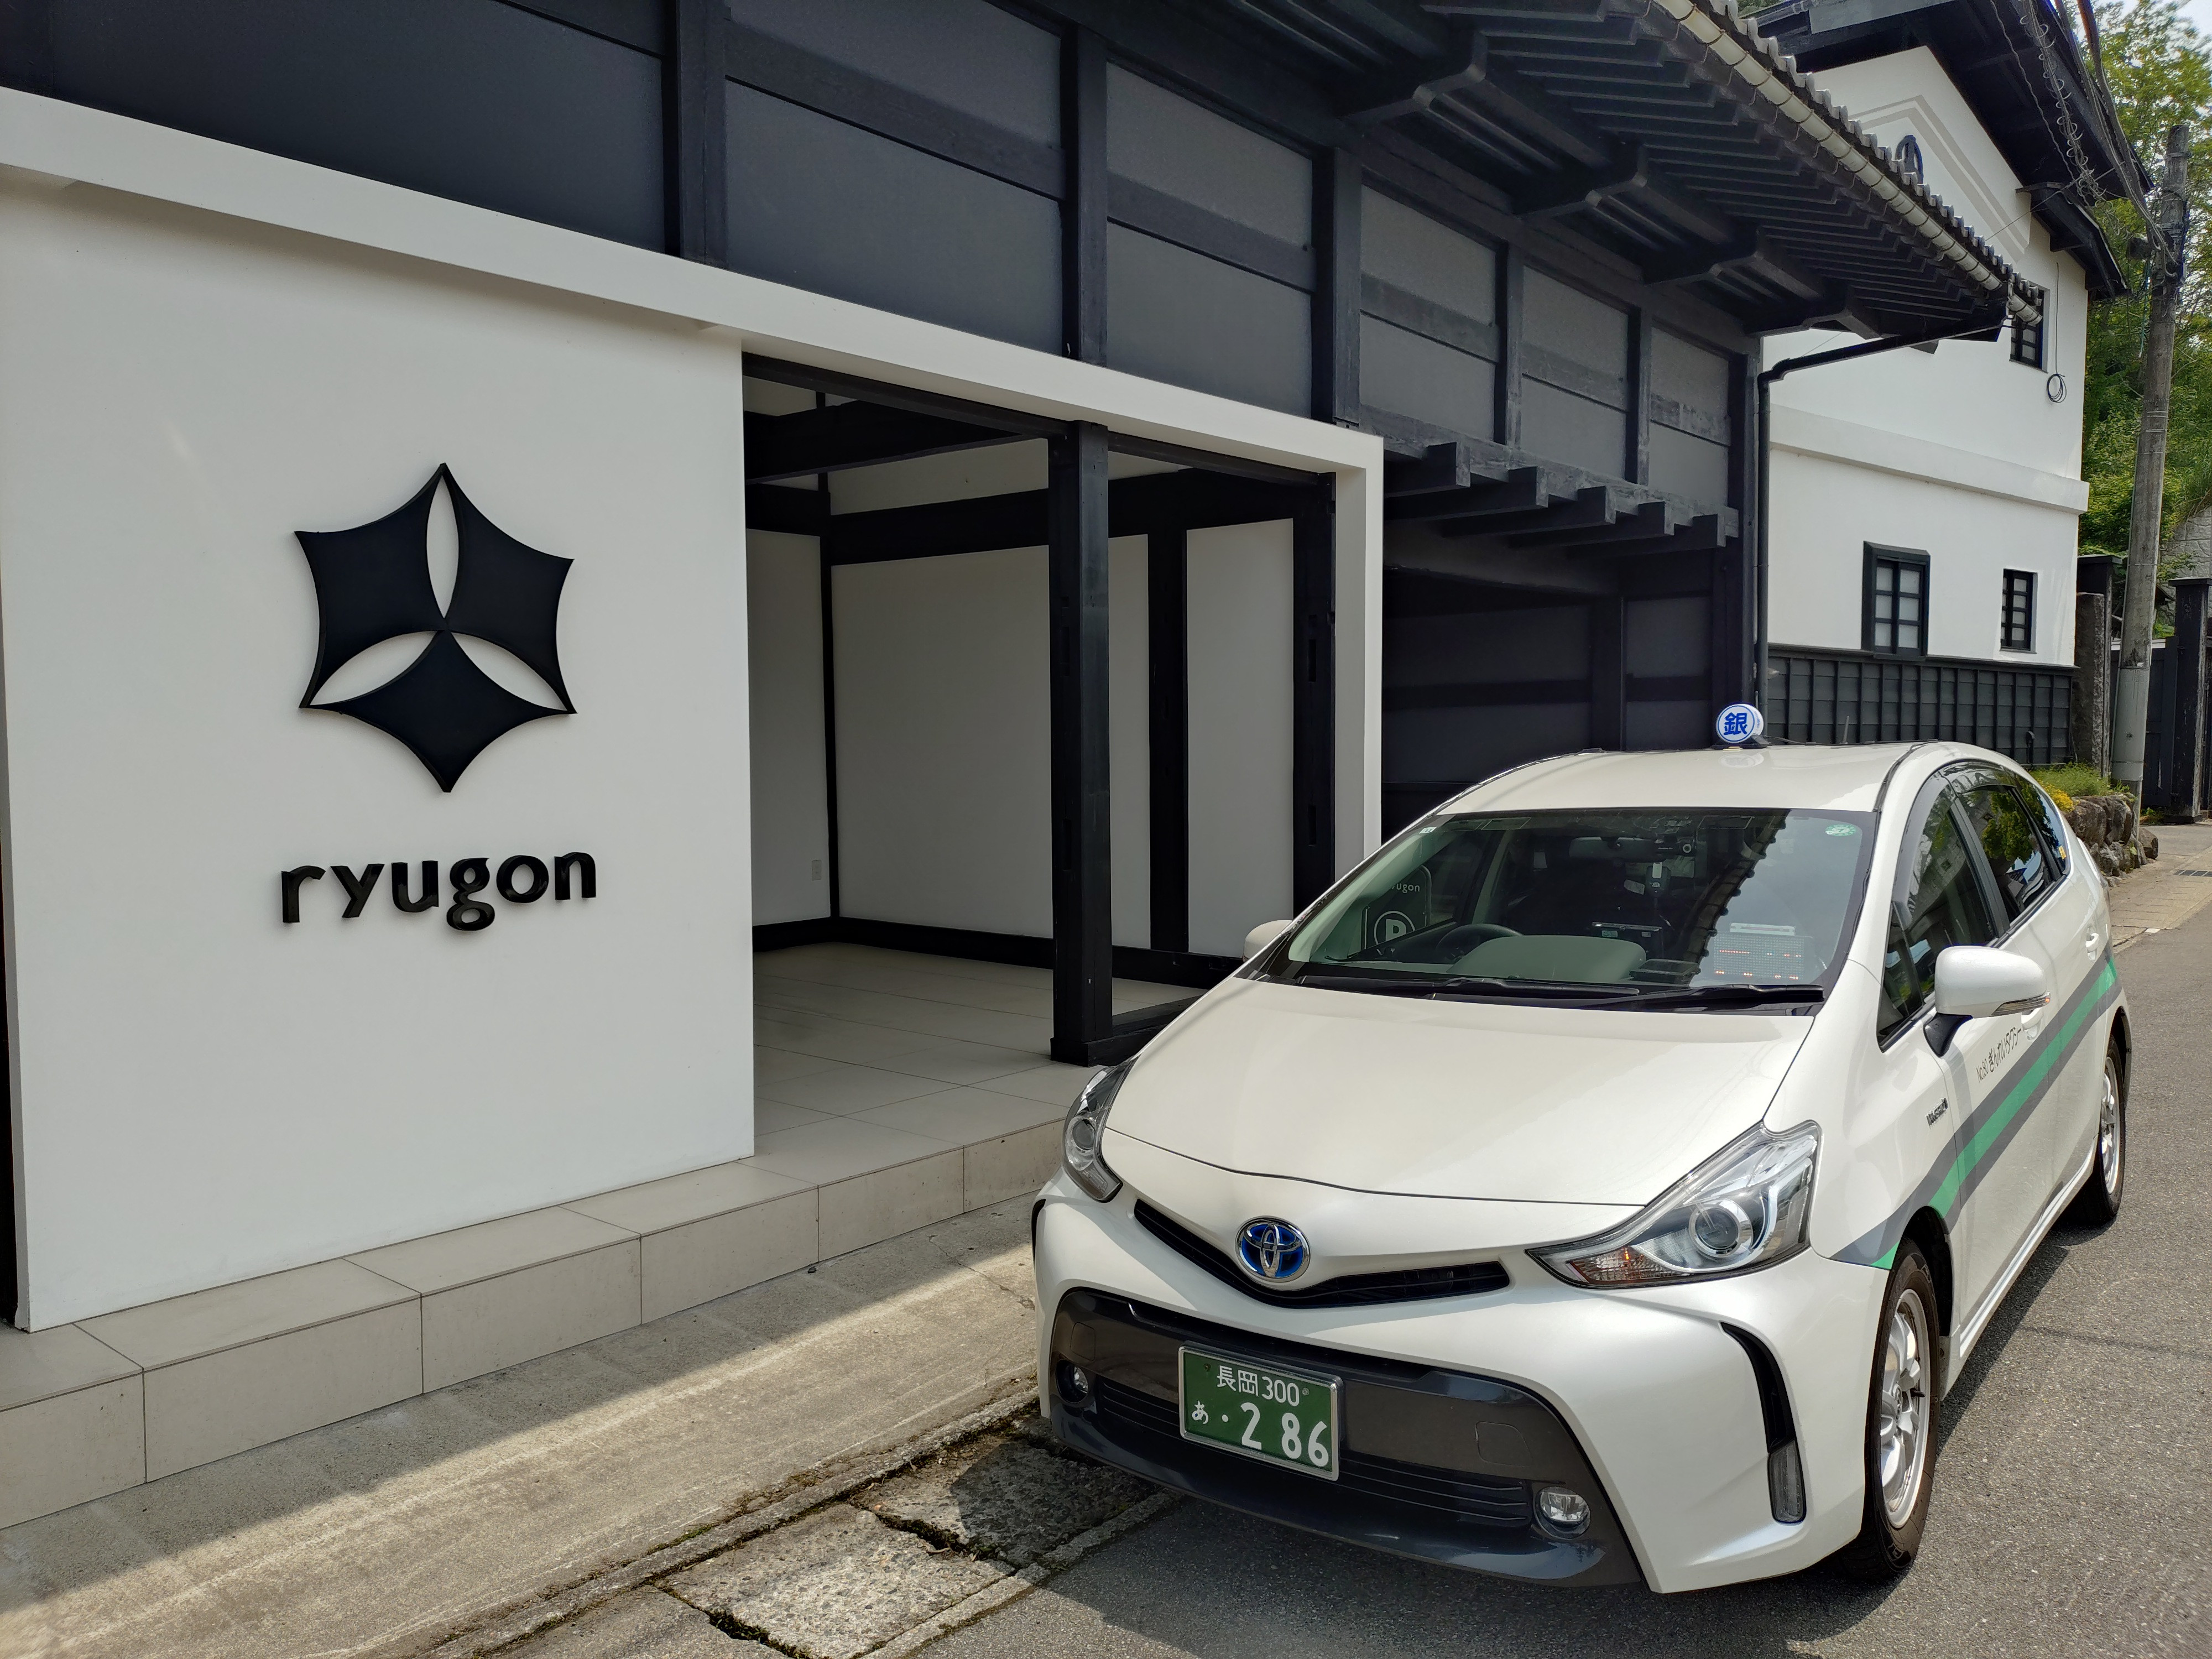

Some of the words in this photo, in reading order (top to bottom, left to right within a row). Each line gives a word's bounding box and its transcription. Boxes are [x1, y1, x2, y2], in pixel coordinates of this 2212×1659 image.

[1724, 712, 1747, 735] 銀
[281, 852, 596, 932] ryugon
[1391, 883, 1420, 894] ugon
[1989, 1027, 2022, 1073] ぎんれいタクシー
